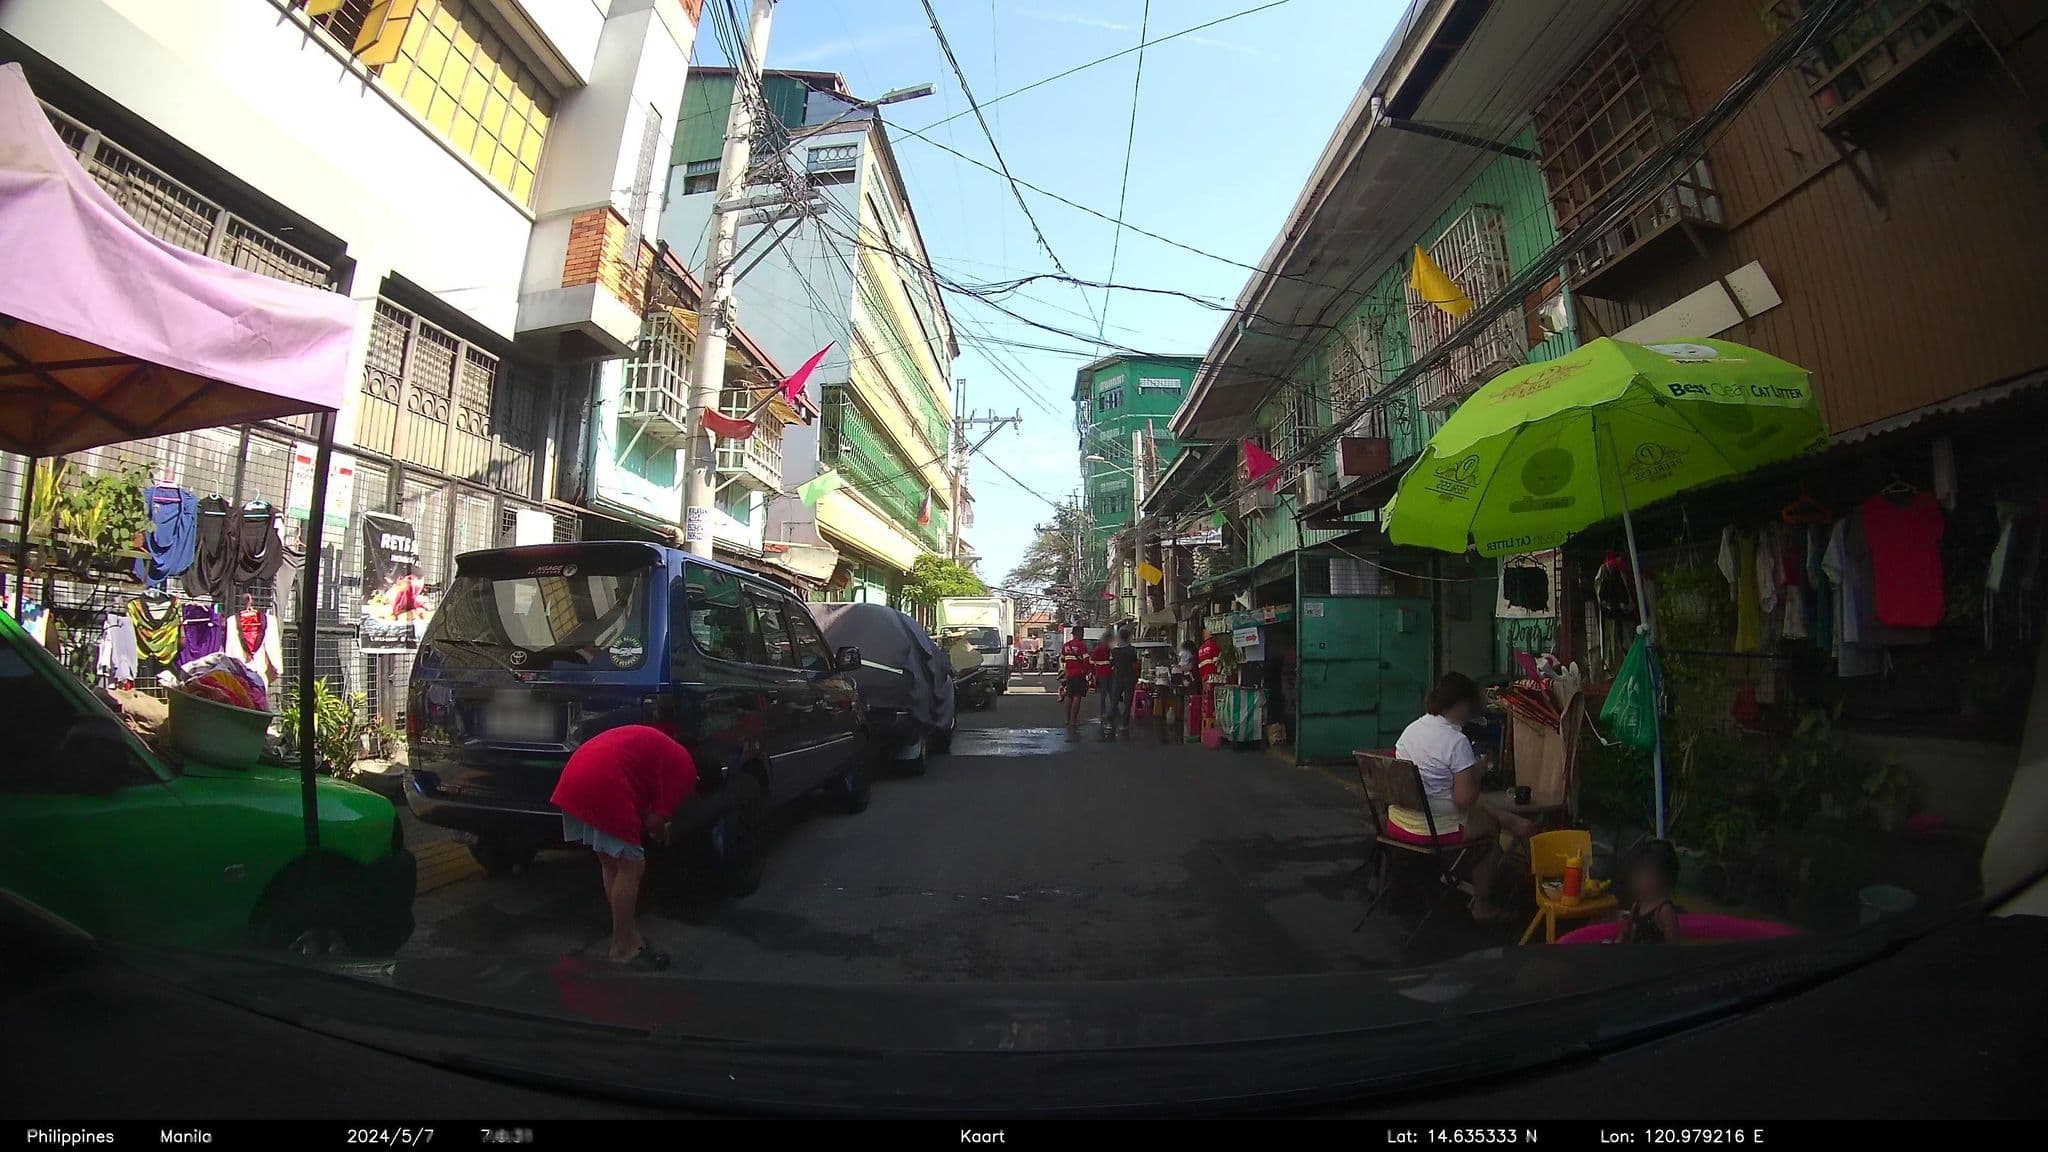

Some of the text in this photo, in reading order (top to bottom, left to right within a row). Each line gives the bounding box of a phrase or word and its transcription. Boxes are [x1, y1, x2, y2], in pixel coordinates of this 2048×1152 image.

[1668, 382, 1711, 397] Best
[1751, 384, 1772, 398] CAT
[1771, 384, 1803, 399] LITTER
